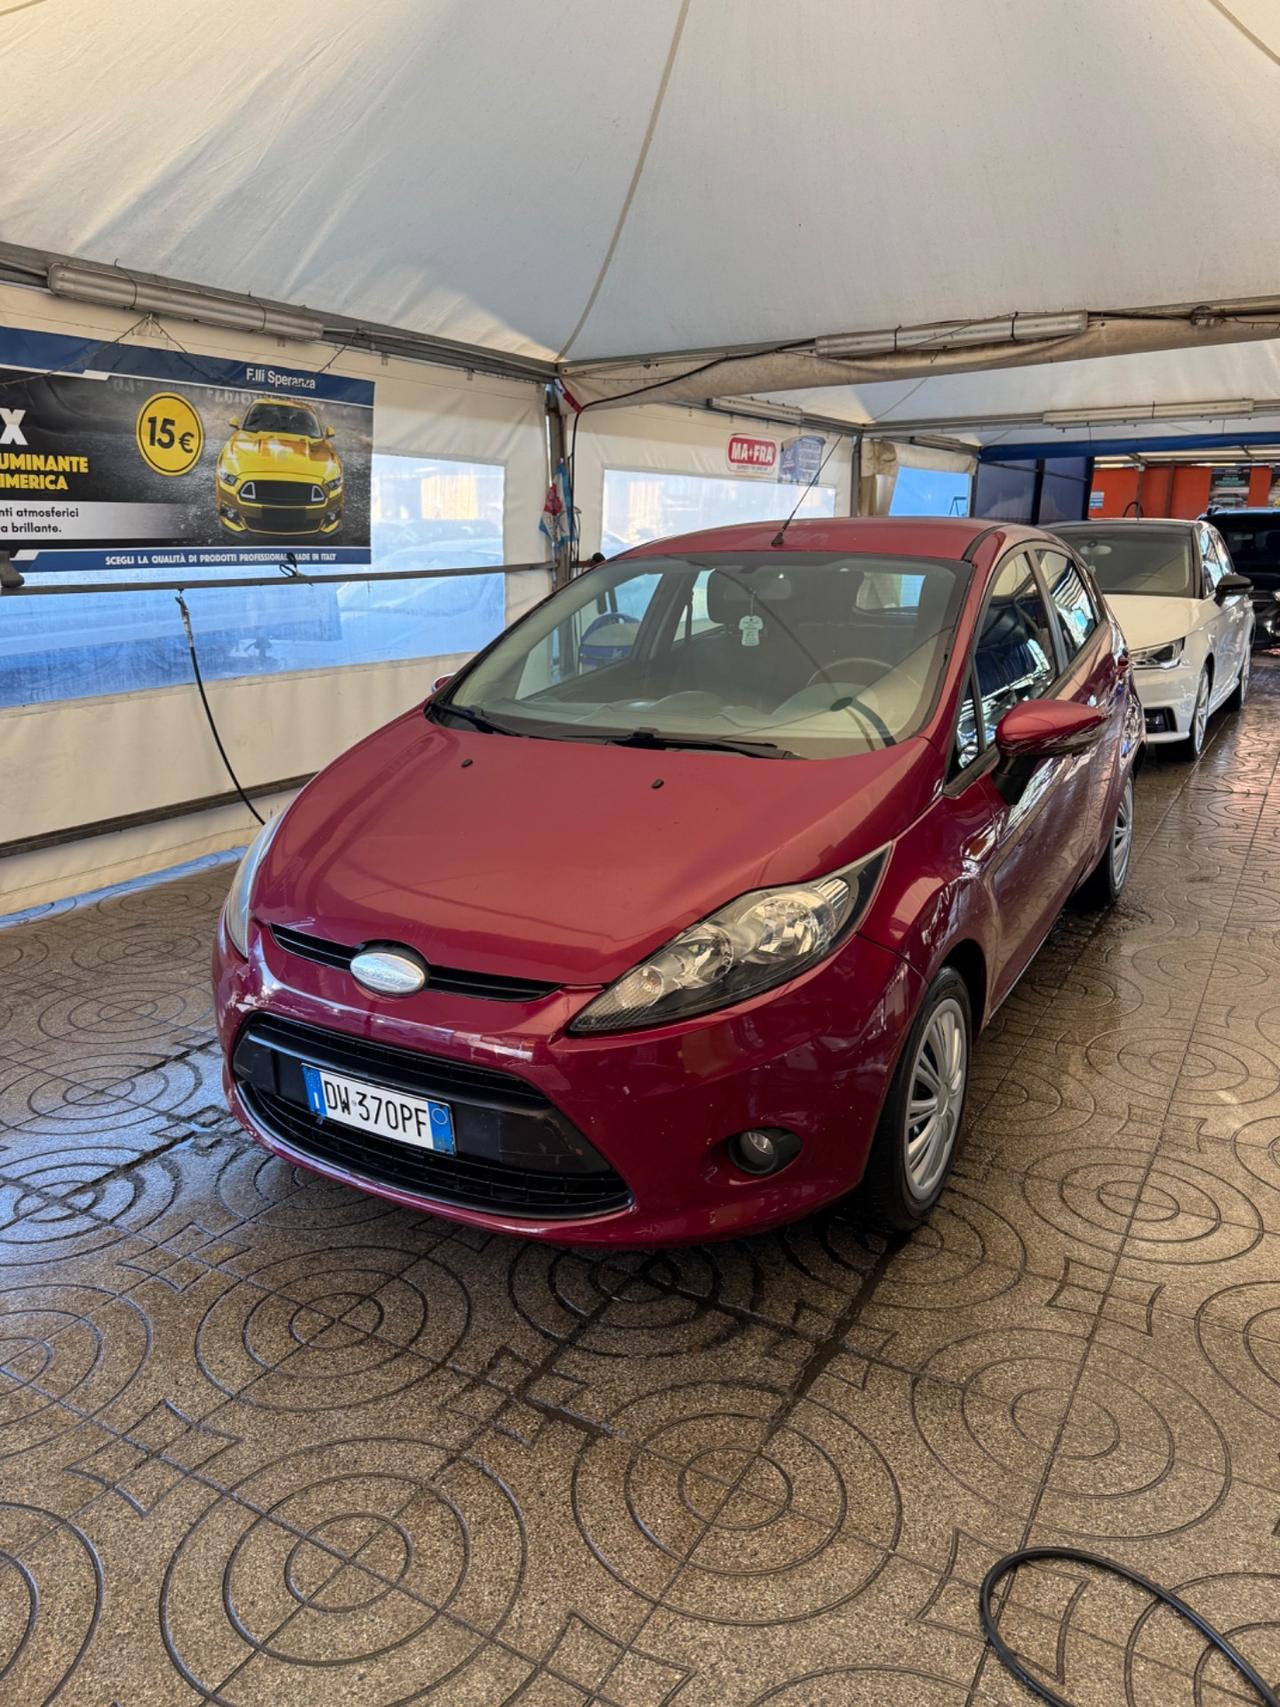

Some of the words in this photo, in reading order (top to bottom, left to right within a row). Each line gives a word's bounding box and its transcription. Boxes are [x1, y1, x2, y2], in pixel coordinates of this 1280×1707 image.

[267, 370, 316, 389] Speranza
[16, 506, 79, 518] atmosferici
[12, 522, 62, 533] brillante.
[105, 555, 135, 566] SCEGLI
[138, 555, 149, 565] LA
[151, 553, 186, 564] QUALITÀ
[188, 555, 197, 563] DI
[200, 554, 237, 563] PRODOTTI
[240, 553, 290, 562] PROFESSIONAL
[311, 553, 320, 561] IN
[320, 553, 337, 561] ITALY
